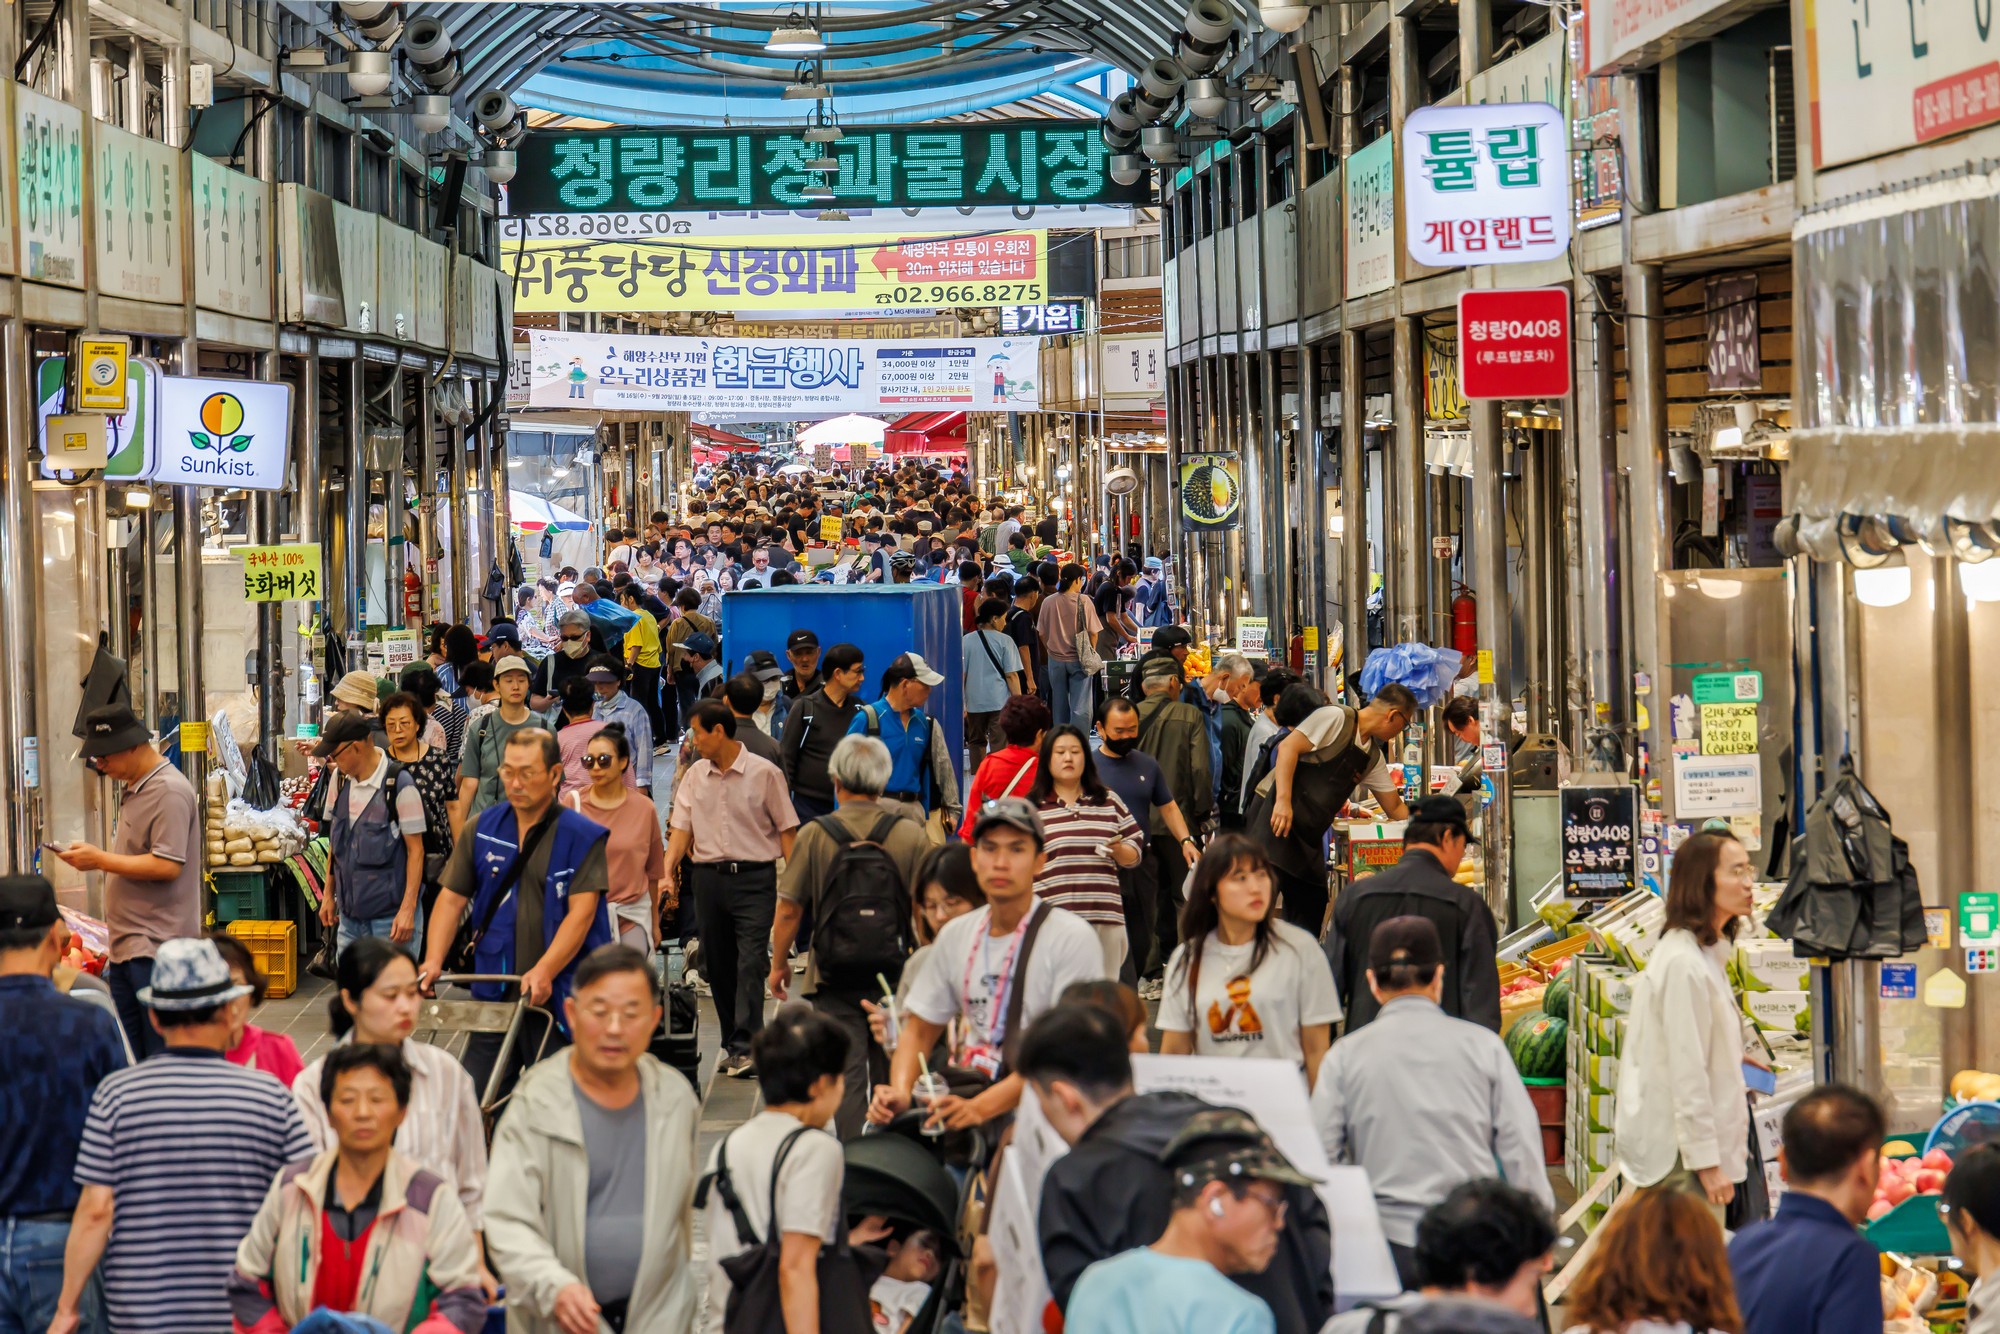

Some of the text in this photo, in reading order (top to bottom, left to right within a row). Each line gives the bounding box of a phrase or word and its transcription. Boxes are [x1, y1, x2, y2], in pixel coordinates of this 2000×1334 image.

[1416, 123, 1549, 193] 튤립
[103, 143, 171, 268] 남양유통
[203, 176, 263, 288] 광주상회
[1423, 216, 1556, 255] 게임랜드
[902, 238, 1030, 259] 세광약국 모퉁이 우회전
[511, 247, 859, 303] 위풍당당 신경외과
[905, 258, 1026, 276] 30m 위치해 있습니다
[893, 284, 1042, 304] 02.966.8275
[1469, 319, 1562, 341] 청량0408
[623, 350, 707, 365] 해양수산부 지원
[882, 359, 969, 368] 34,000원 이상 1만원
[1476, 348, 1555, 365] (루프탑포차)
[598, 365, 707, 388] 온누리상품권
[712, 345, 864, 389] 환급행사
[881, 372, 969, 381] 67,000원 이상 2만원
[880, 386, 909, 394] 행사기간
[910, 385, 920, 394] 내,
[922, 385, 934, 393] 1인
[936, 385, 955, 393] 2만원
[181, 456, 255, 477] Sunkist
[248, 552, 304, 567] 국내산 100%
[1242, 630, 1263, 639] 환급행
[1242, 639, 1263, 648] 참여점
[388, 643, 413, 653] 환급행사
[389, 653, 414, 662] 참여점포
[1565, 824, 1631, 844] 청량0408
[1366, 857, 1398, 865] FARMS
[1565, 846, 1631, 868] 오늘휴무
